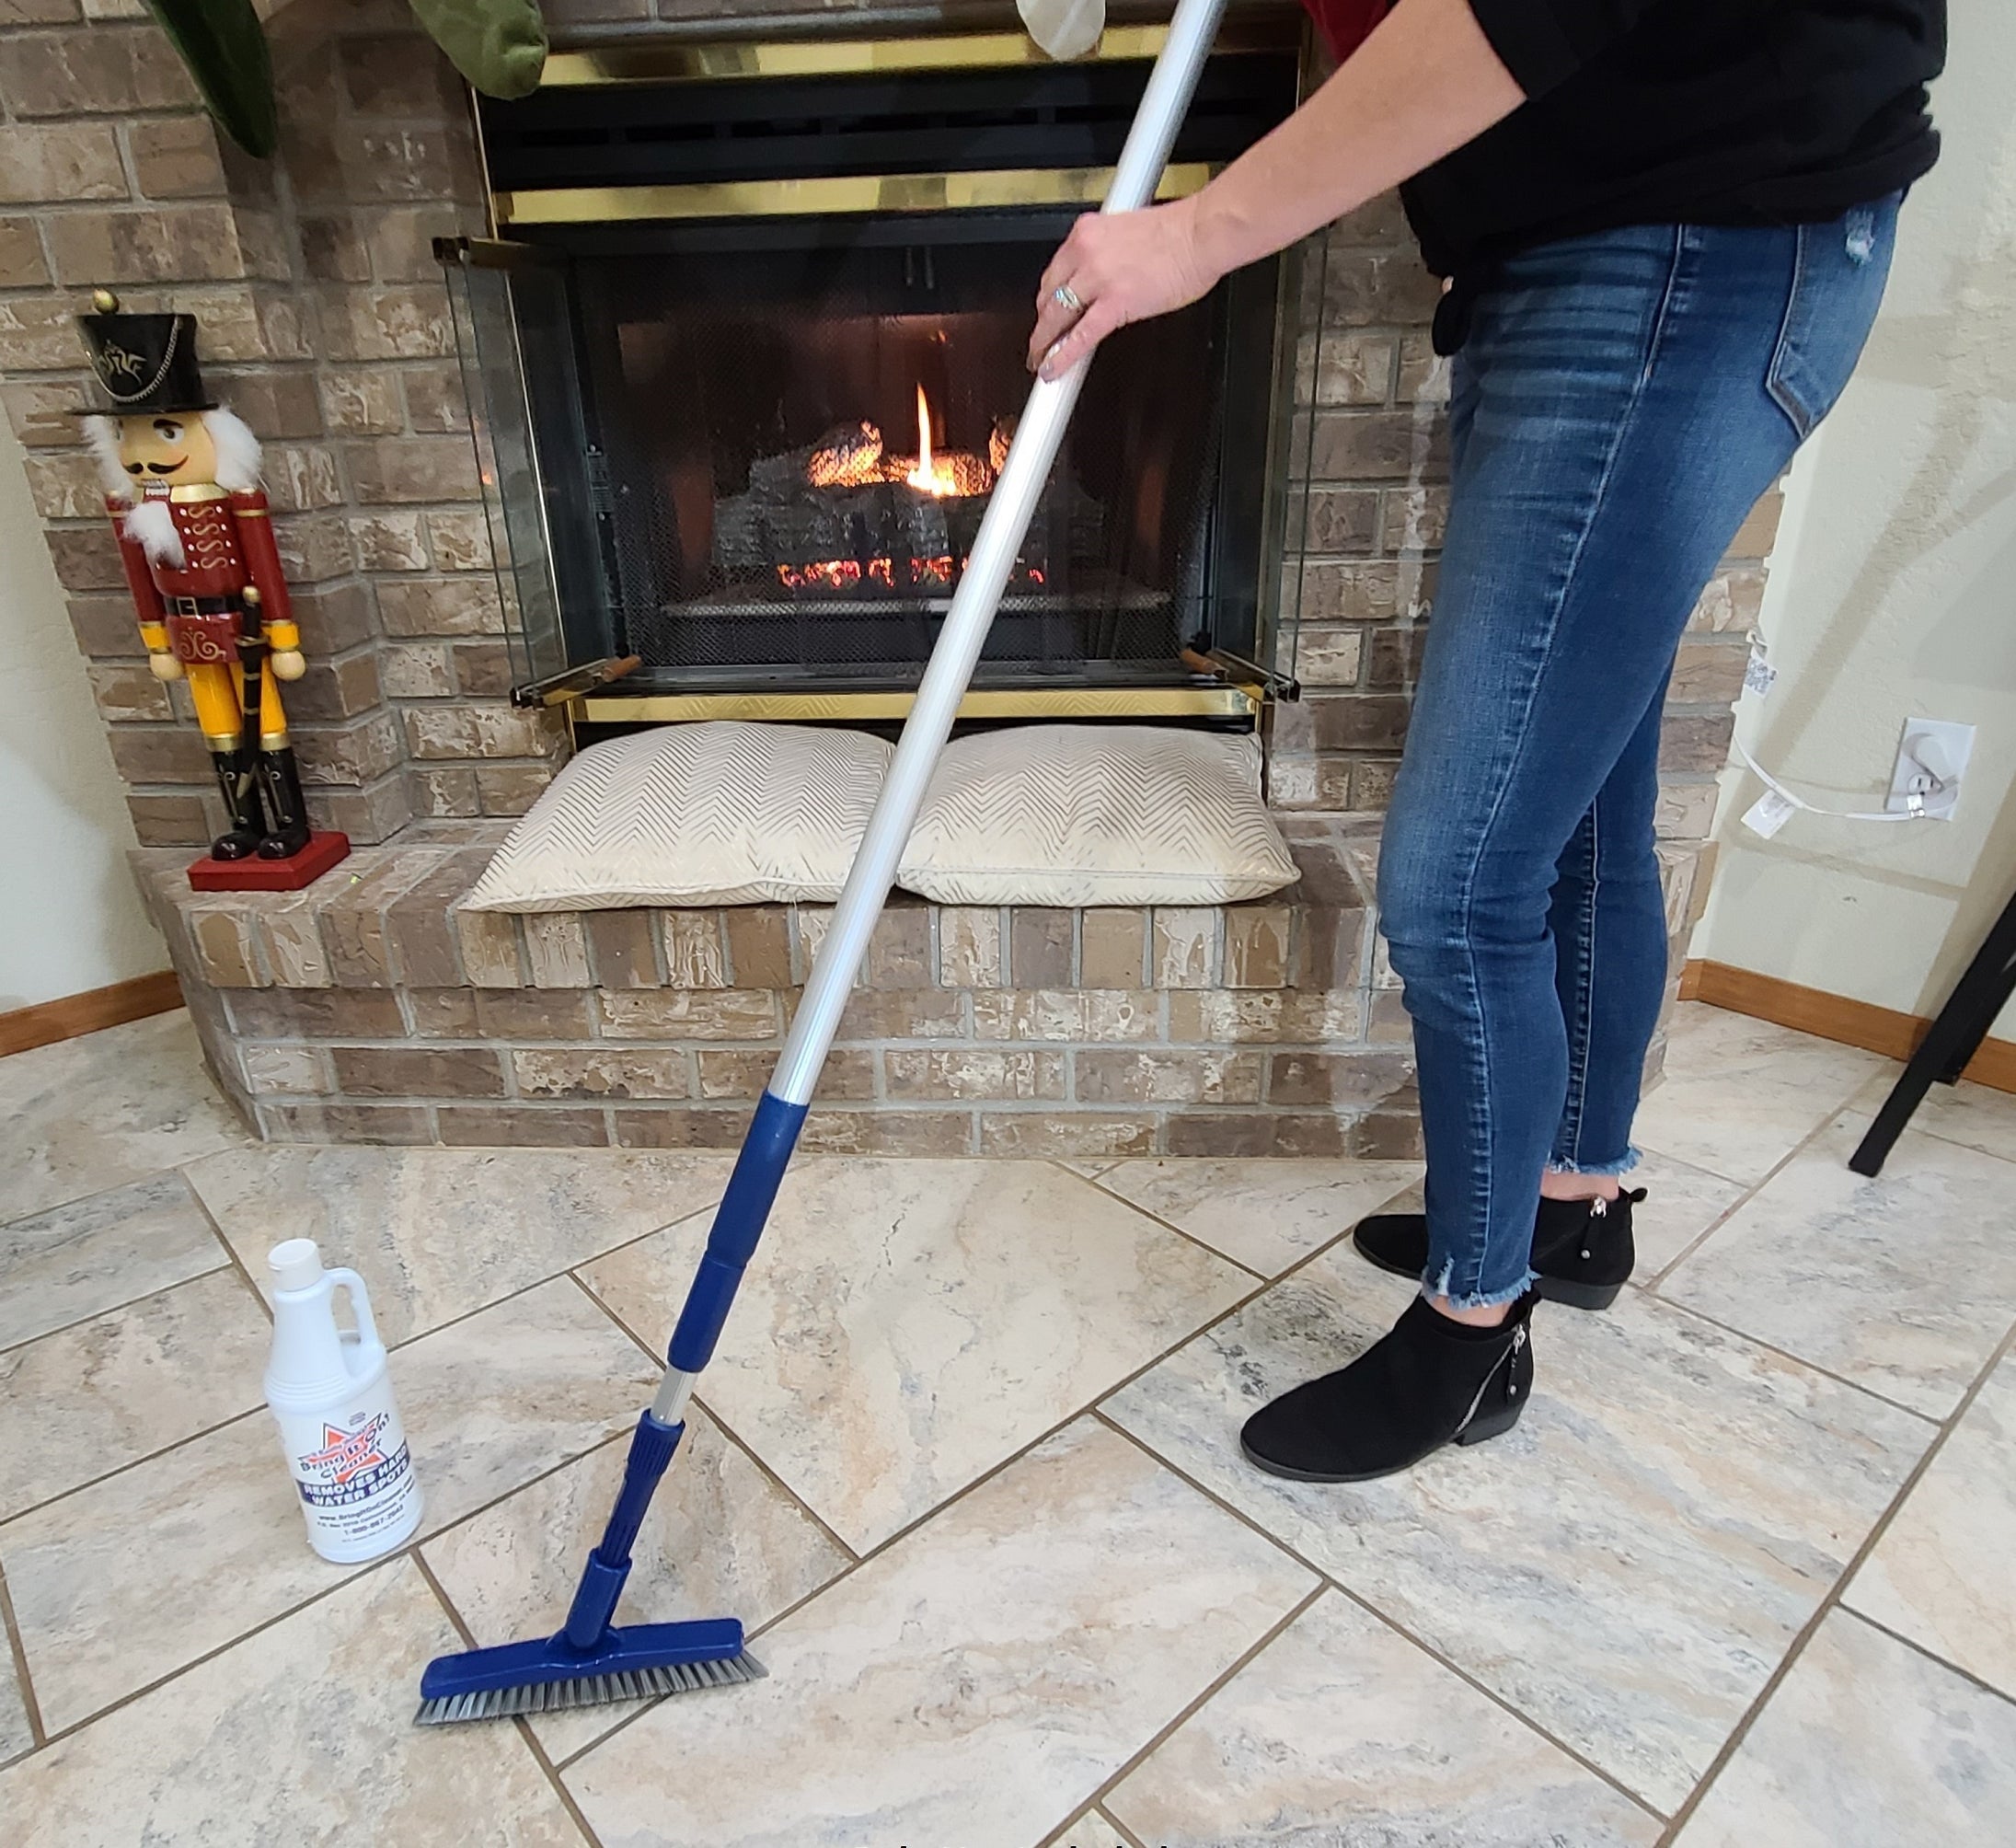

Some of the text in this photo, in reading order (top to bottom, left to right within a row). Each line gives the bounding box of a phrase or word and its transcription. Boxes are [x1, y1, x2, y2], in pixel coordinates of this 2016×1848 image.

[300, 1454, 345, 1472] Bring
[347, 1444, 360, 1456] It
[304, 1444, 408, 1496] REMOVES HARD
[320, 1438, 382, 1479] Cleaner
[312, 1488, 366, 1507] WATER
[368, 1457, 409, 1496] SPOTS
